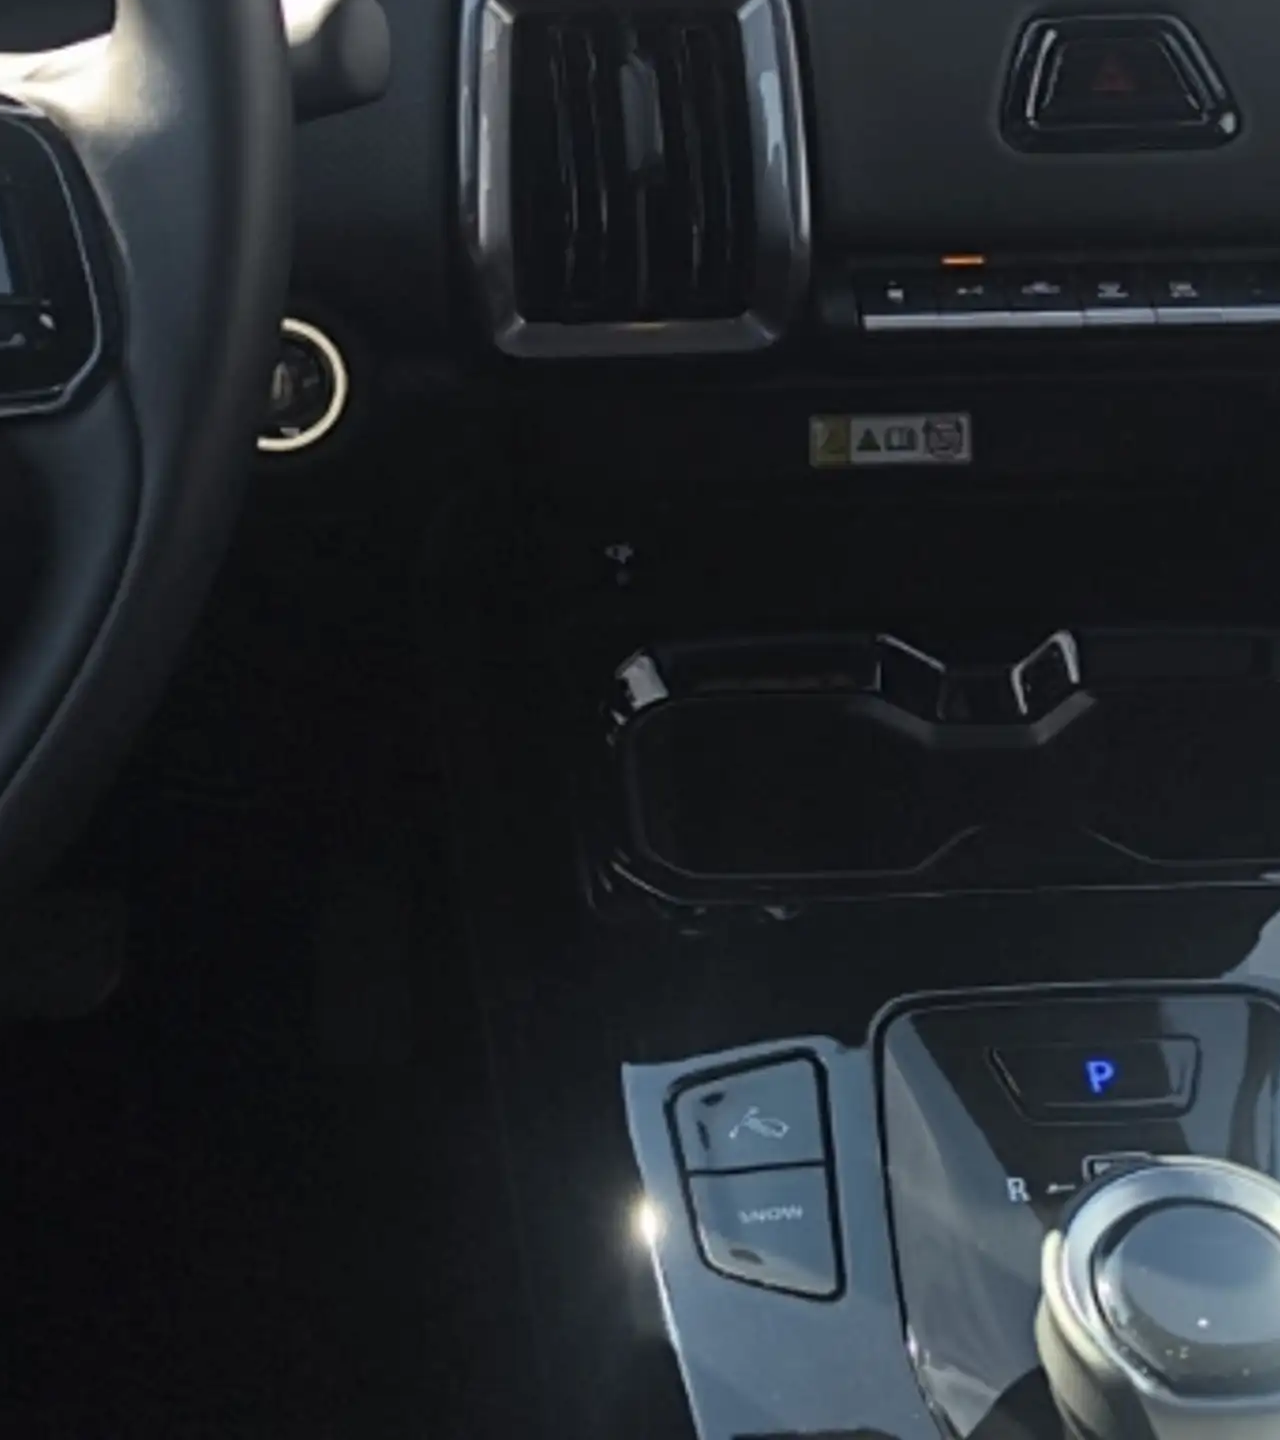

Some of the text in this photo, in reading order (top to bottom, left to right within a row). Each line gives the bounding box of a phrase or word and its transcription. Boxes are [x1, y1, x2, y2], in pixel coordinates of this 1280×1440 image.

[1084, 1059, 1116, 1094] P
[1006, 1176, 1032, 1202] R
[737, 1204, 804, 1225] SNOW
